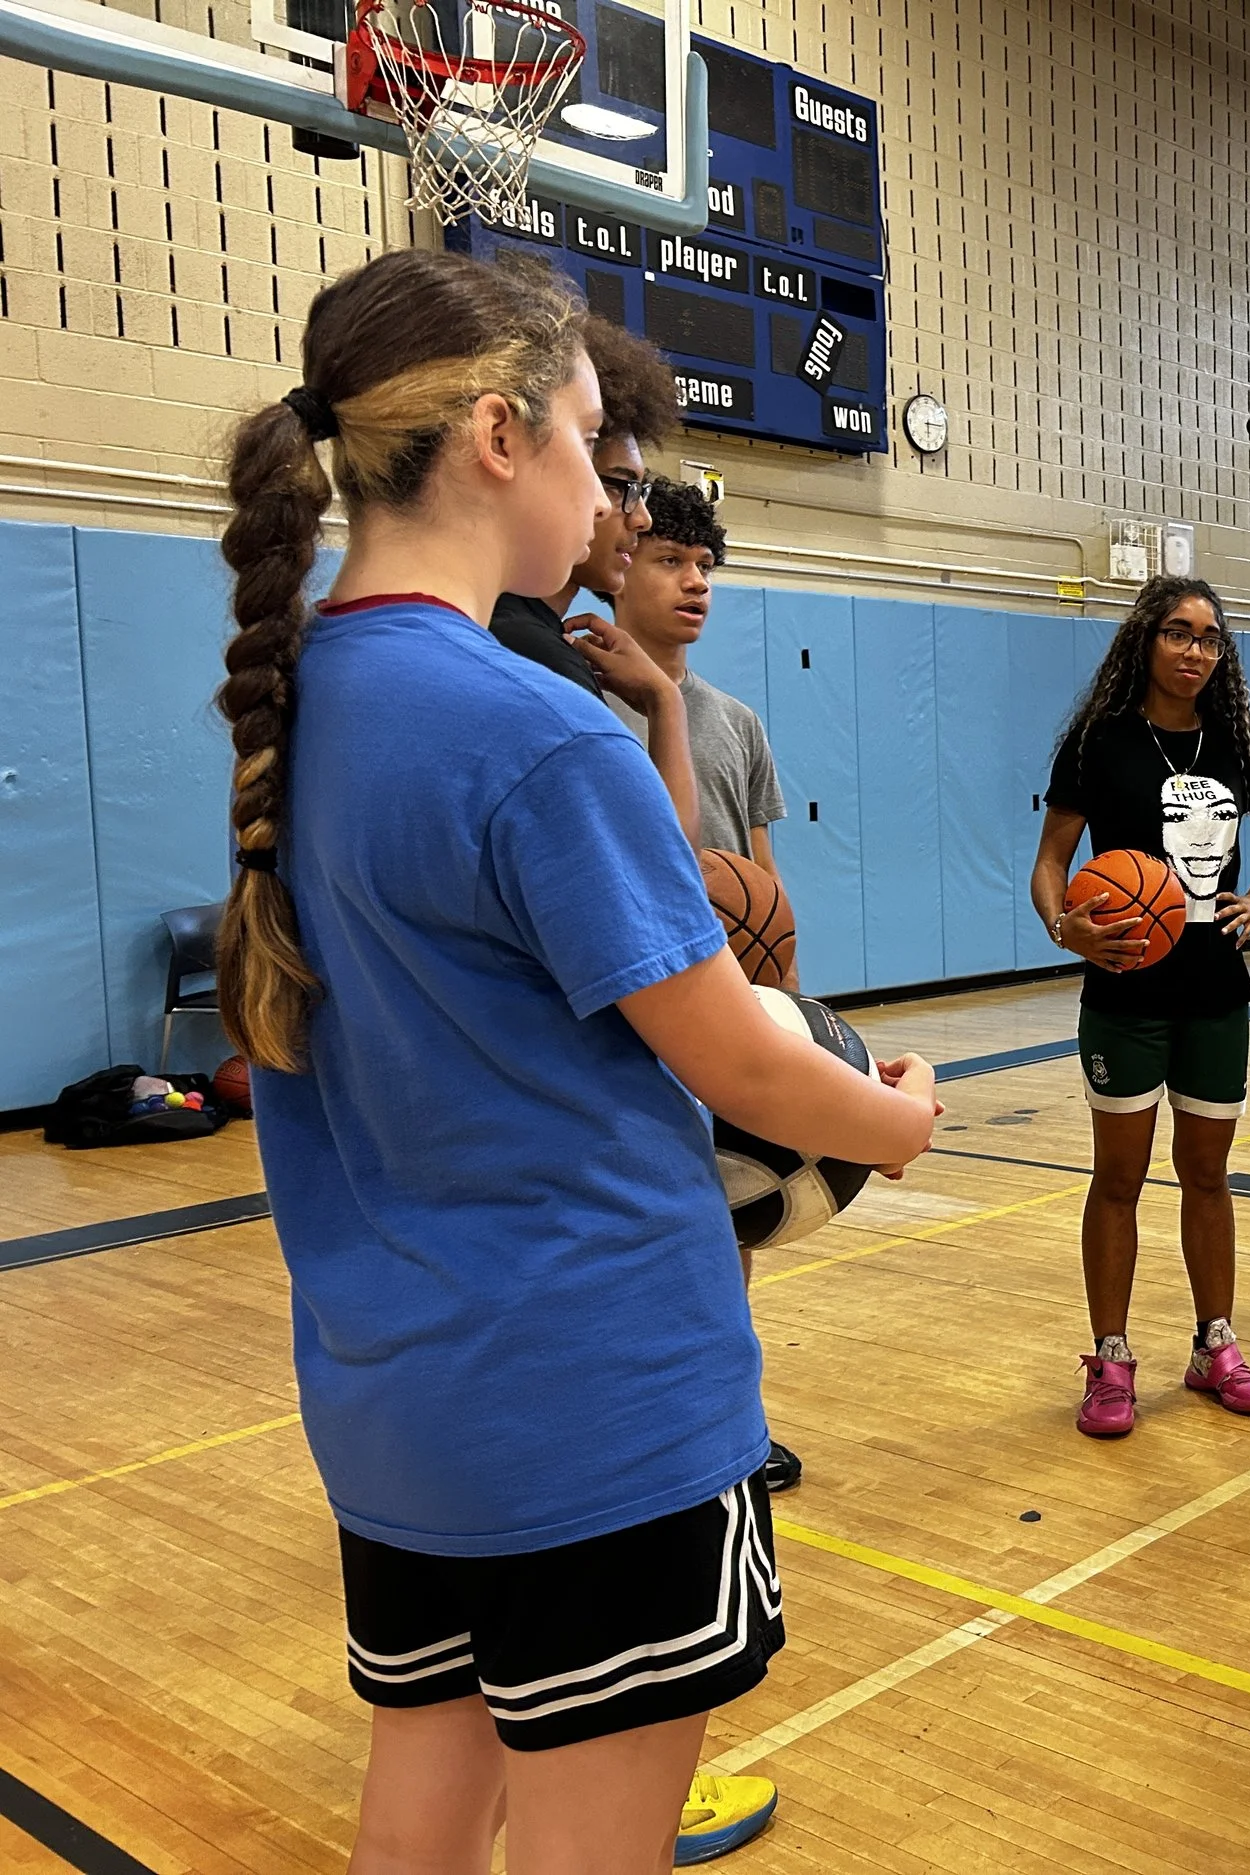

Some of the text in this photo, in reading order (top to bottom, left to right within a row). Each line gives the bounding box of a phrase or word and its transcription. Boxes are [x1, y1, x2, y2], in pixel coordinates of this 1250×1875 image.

[793, 86, 867, 142] Guests
[661, 235, 738, 283] player
[763, 266, 808, 302] t.o.l.
[804, 318, 843, 381] fouls
[674, 375, 733, 408] game
[832, 405, 872, 434] won
[1172, 791, 1217, 802] THUG
